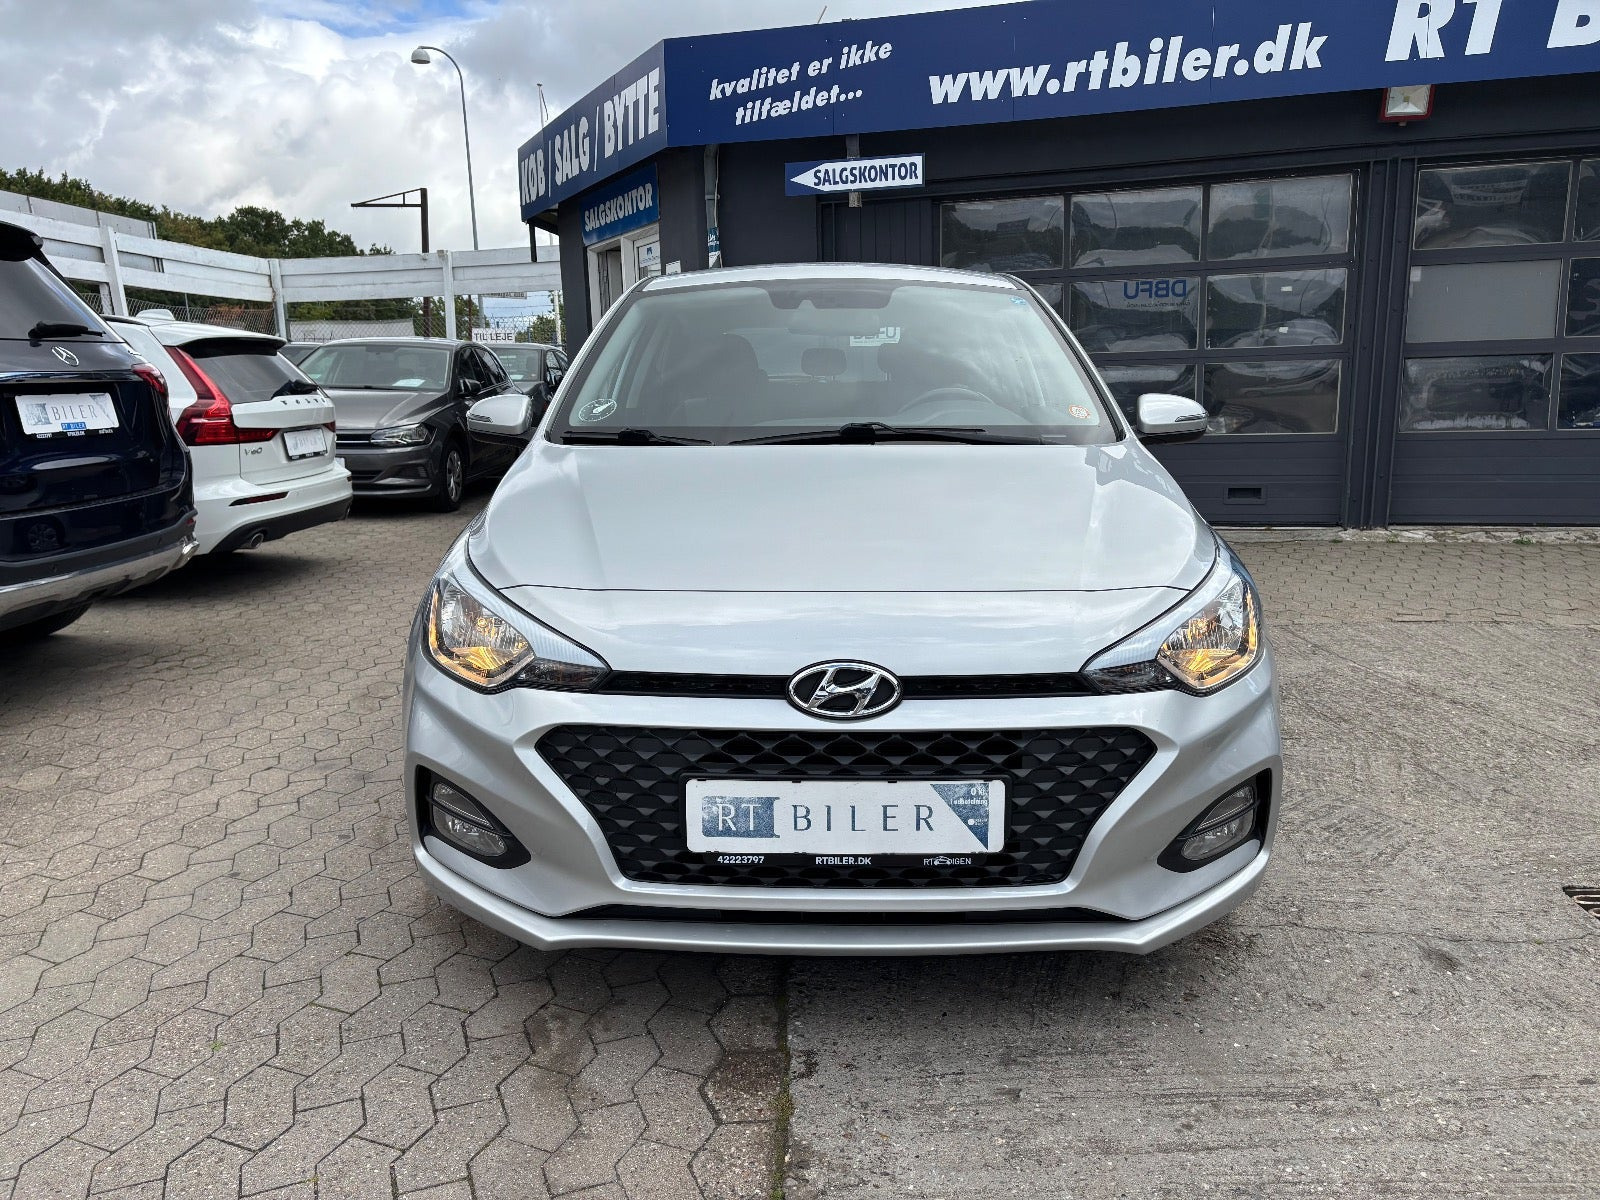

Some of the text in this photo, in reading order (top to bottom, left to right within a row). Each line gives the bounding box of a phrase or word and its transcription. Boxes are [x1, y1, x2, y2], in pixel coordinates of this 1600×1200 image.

[709, 40, 893, 100] kvalitet er ikke
[928, 22, 1328, 105] www.rtbiler.dk
[735, 84, 863, 126] tilfældet...
[520, 148, 546, 206] KØB
[554, 116, 590, 186] SALG
[603, 67, 660, 159] BYTTE
[813, 161, 919, 187] SALGSKONTOR
[584, 182, 653, 232] SALGSKONTOR
[474, 332, 513, 341] TIL LEJE
[717, 803, 934, 832] RT BILER
[717, 856, 765, 864] 42223797
[815, 857, 871, 866] RTBILER.DK
